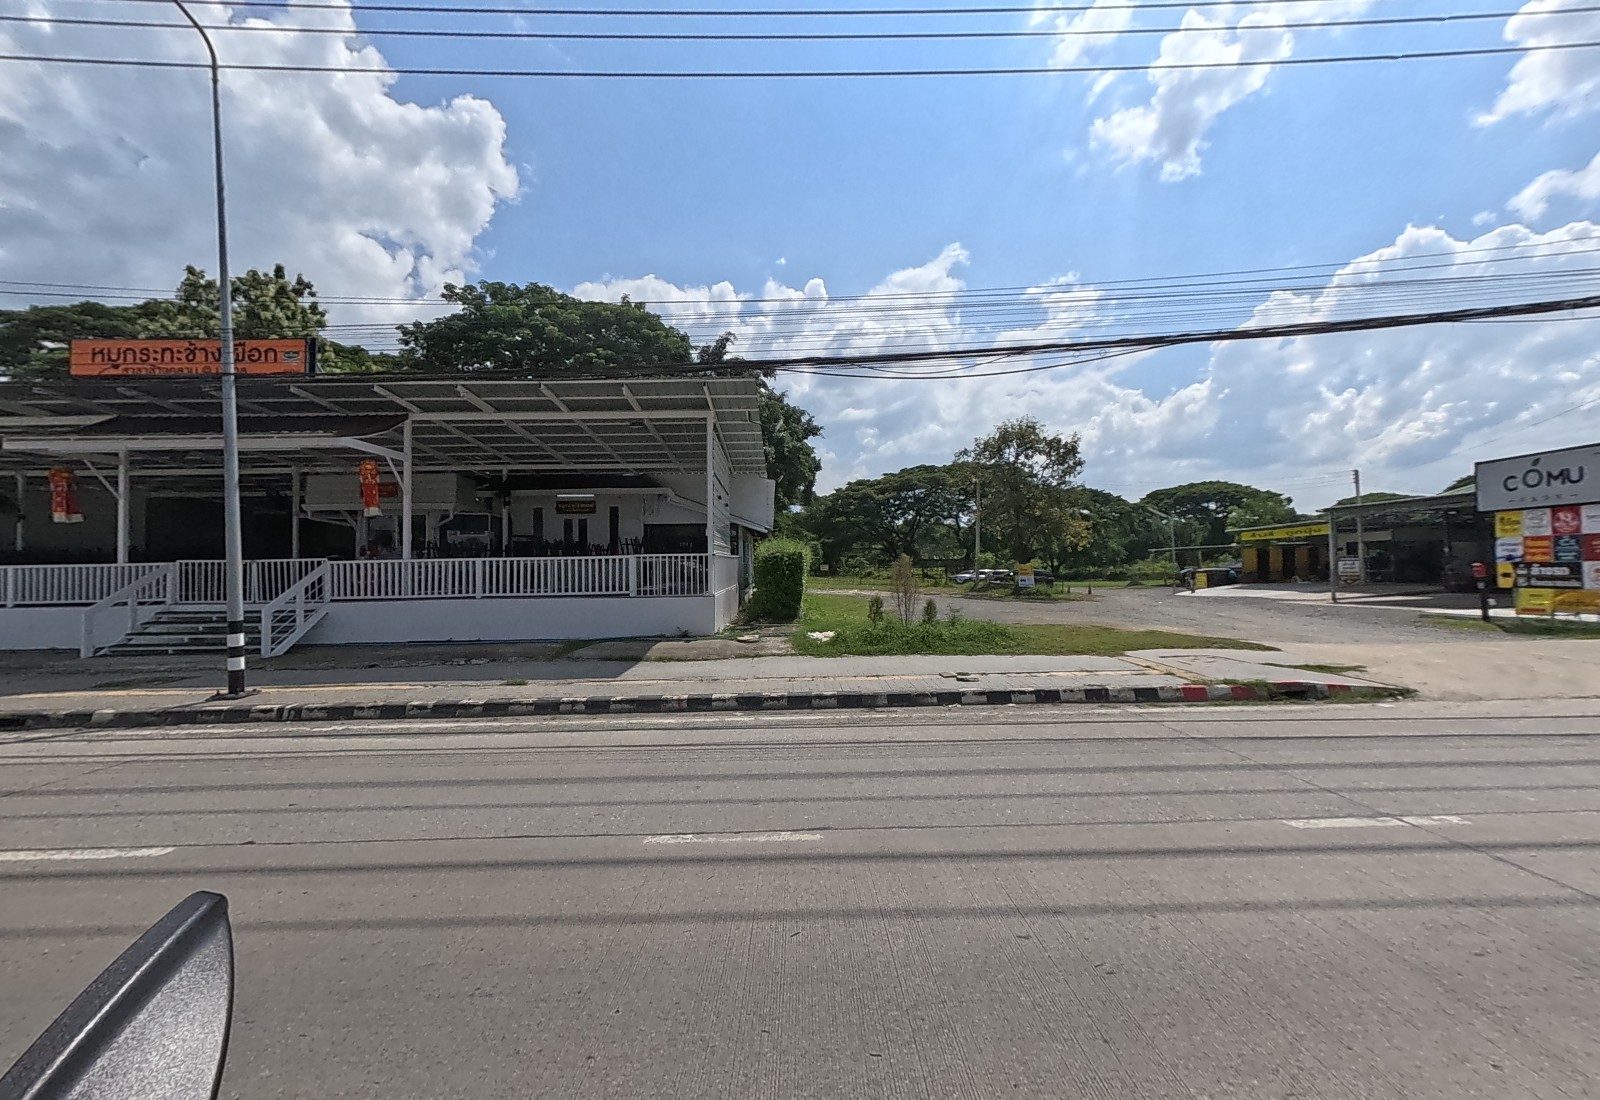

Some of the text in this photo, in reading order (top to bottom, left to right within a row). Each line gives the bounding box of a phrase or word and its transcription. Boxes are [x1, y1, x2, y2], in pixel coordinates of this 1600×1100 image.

[91, 341, 278, 369] หมูกระทะช้างผือก
